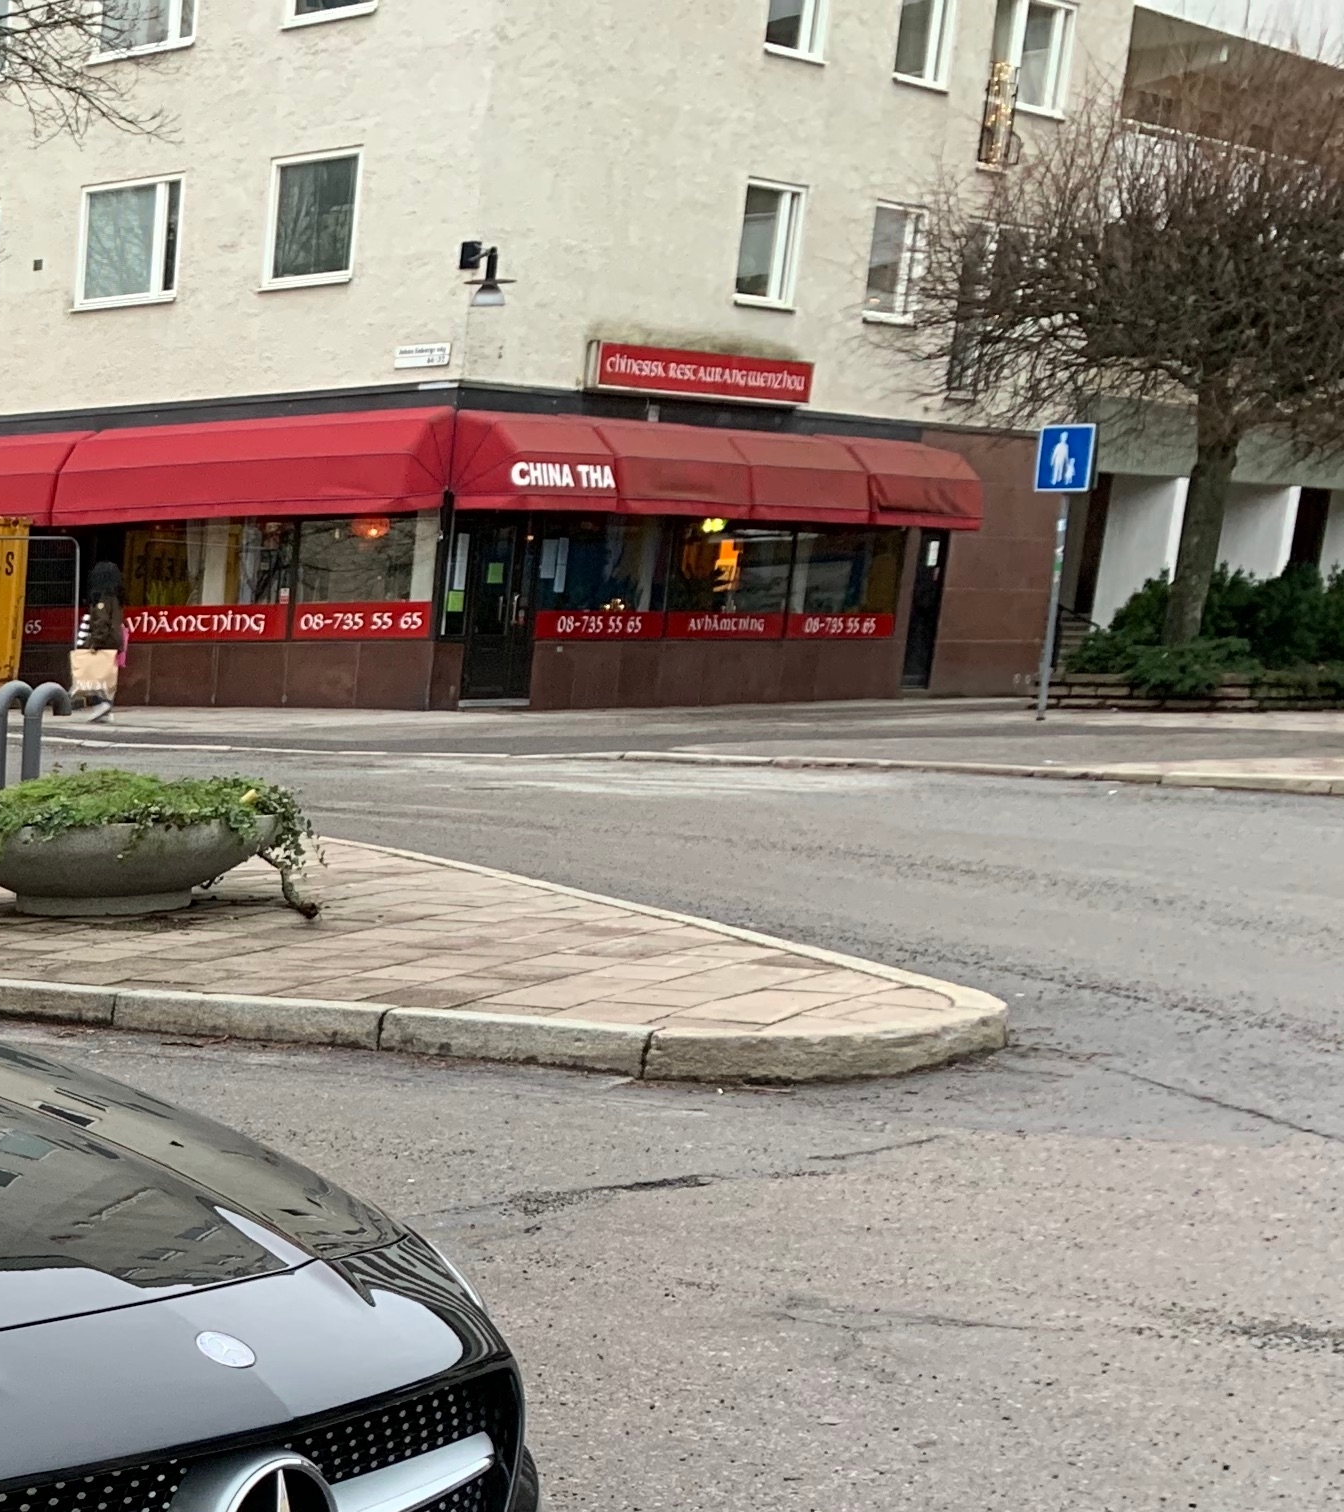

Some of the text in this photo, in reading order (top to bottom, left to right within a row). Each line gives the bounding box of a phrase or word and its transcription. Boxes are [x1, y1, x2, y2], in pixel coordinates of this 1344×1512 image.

[511, 461, 575, 488] CHINA
[24, 619, 42, 635] 65
[300, 610, 423, 631] 08-735 55 65
[556, 616, 642, 634] 08-735 55 65
[803, 617, 877, 634] 08-735 55 65
